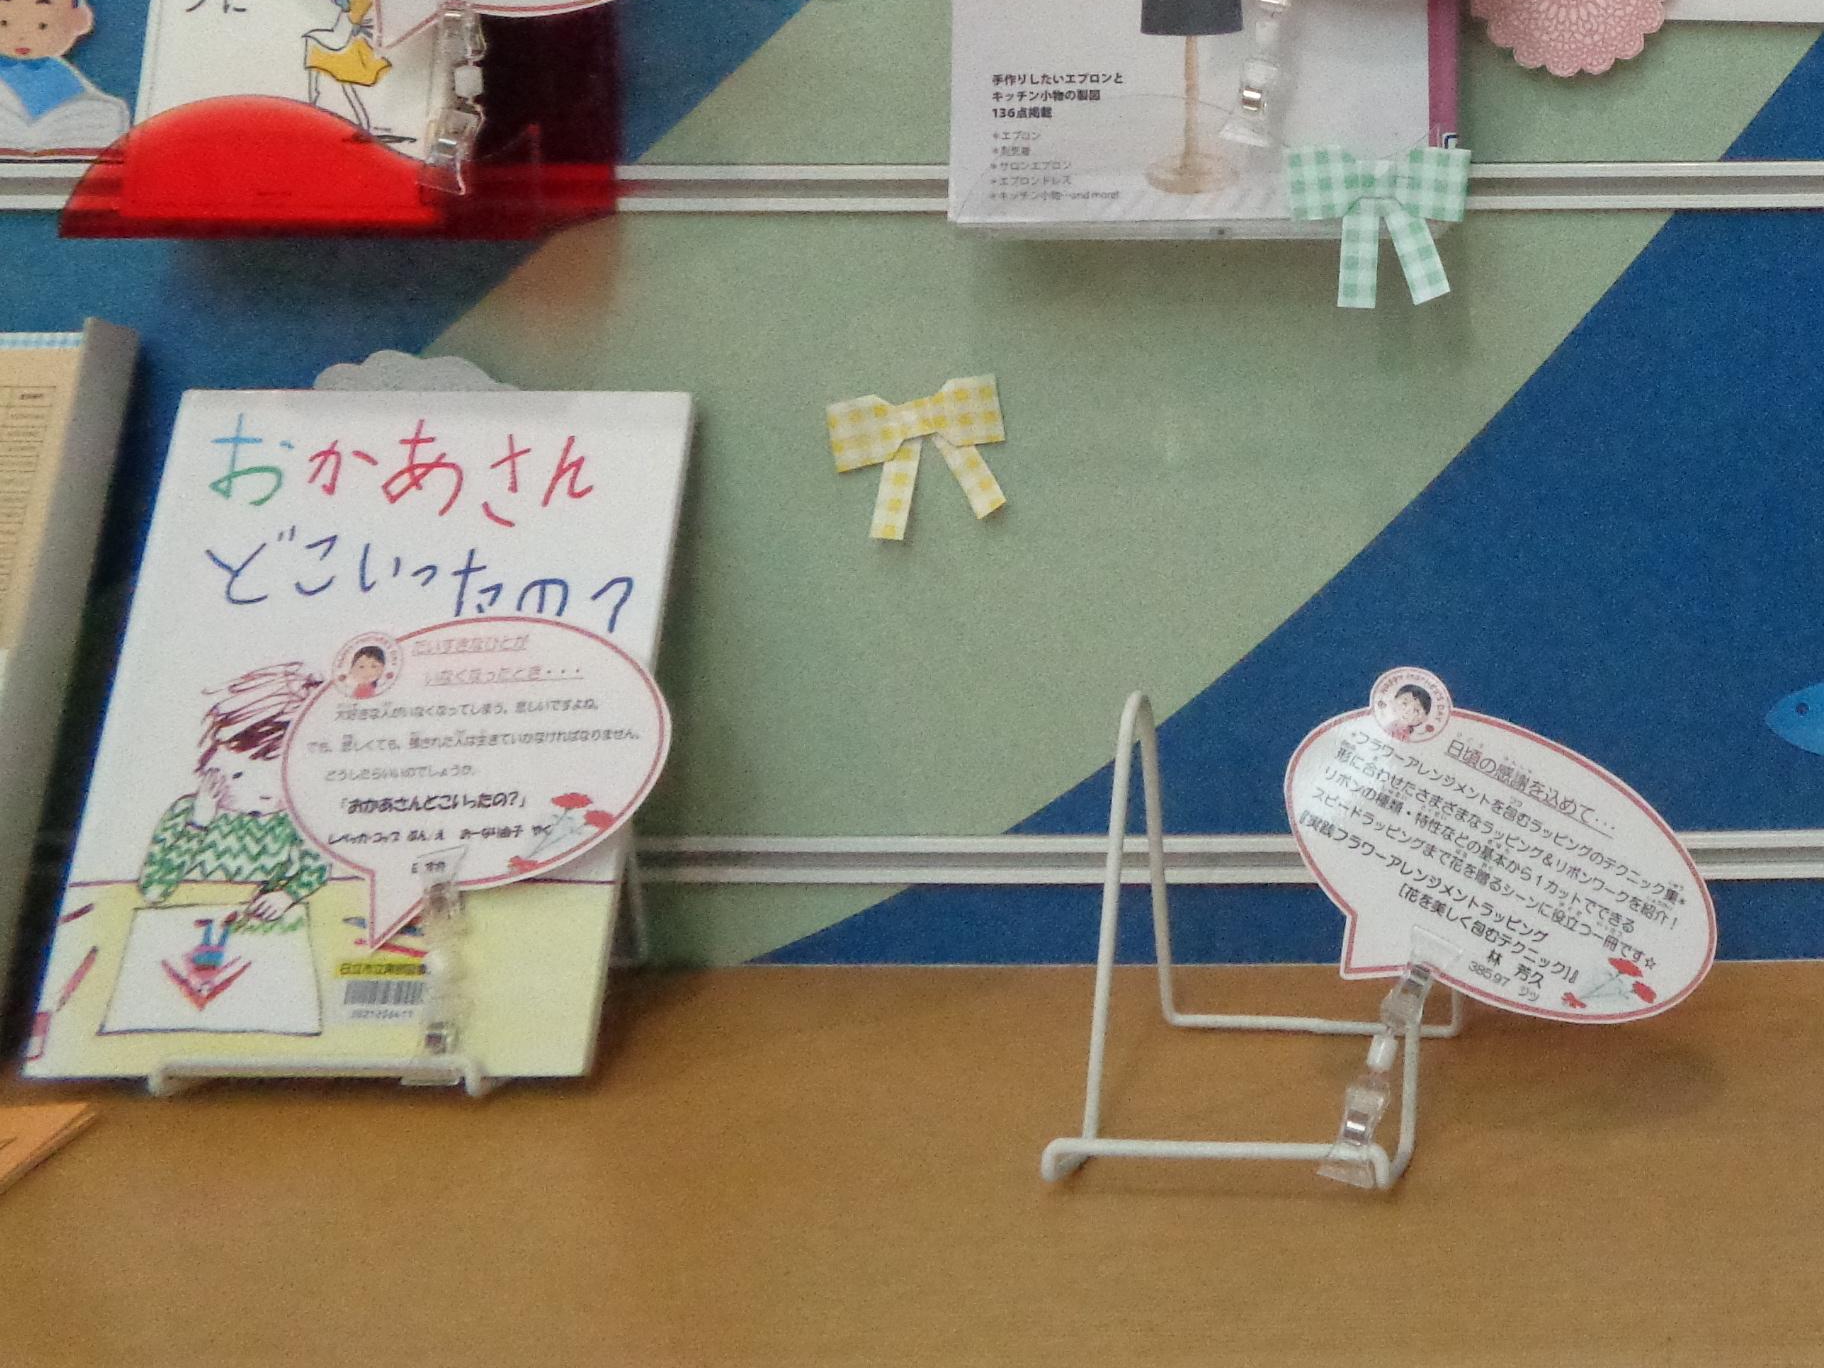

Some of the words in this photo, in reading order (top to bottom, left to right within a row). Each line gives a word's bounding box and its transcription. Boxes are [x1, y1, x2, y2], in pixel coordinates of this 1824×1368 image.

[992, 73, 1124, 86] 手作りしたいエプロンと
[209, 412, 595, 528] おかあさん
[206, 526, 636, 632] どこいったの？
